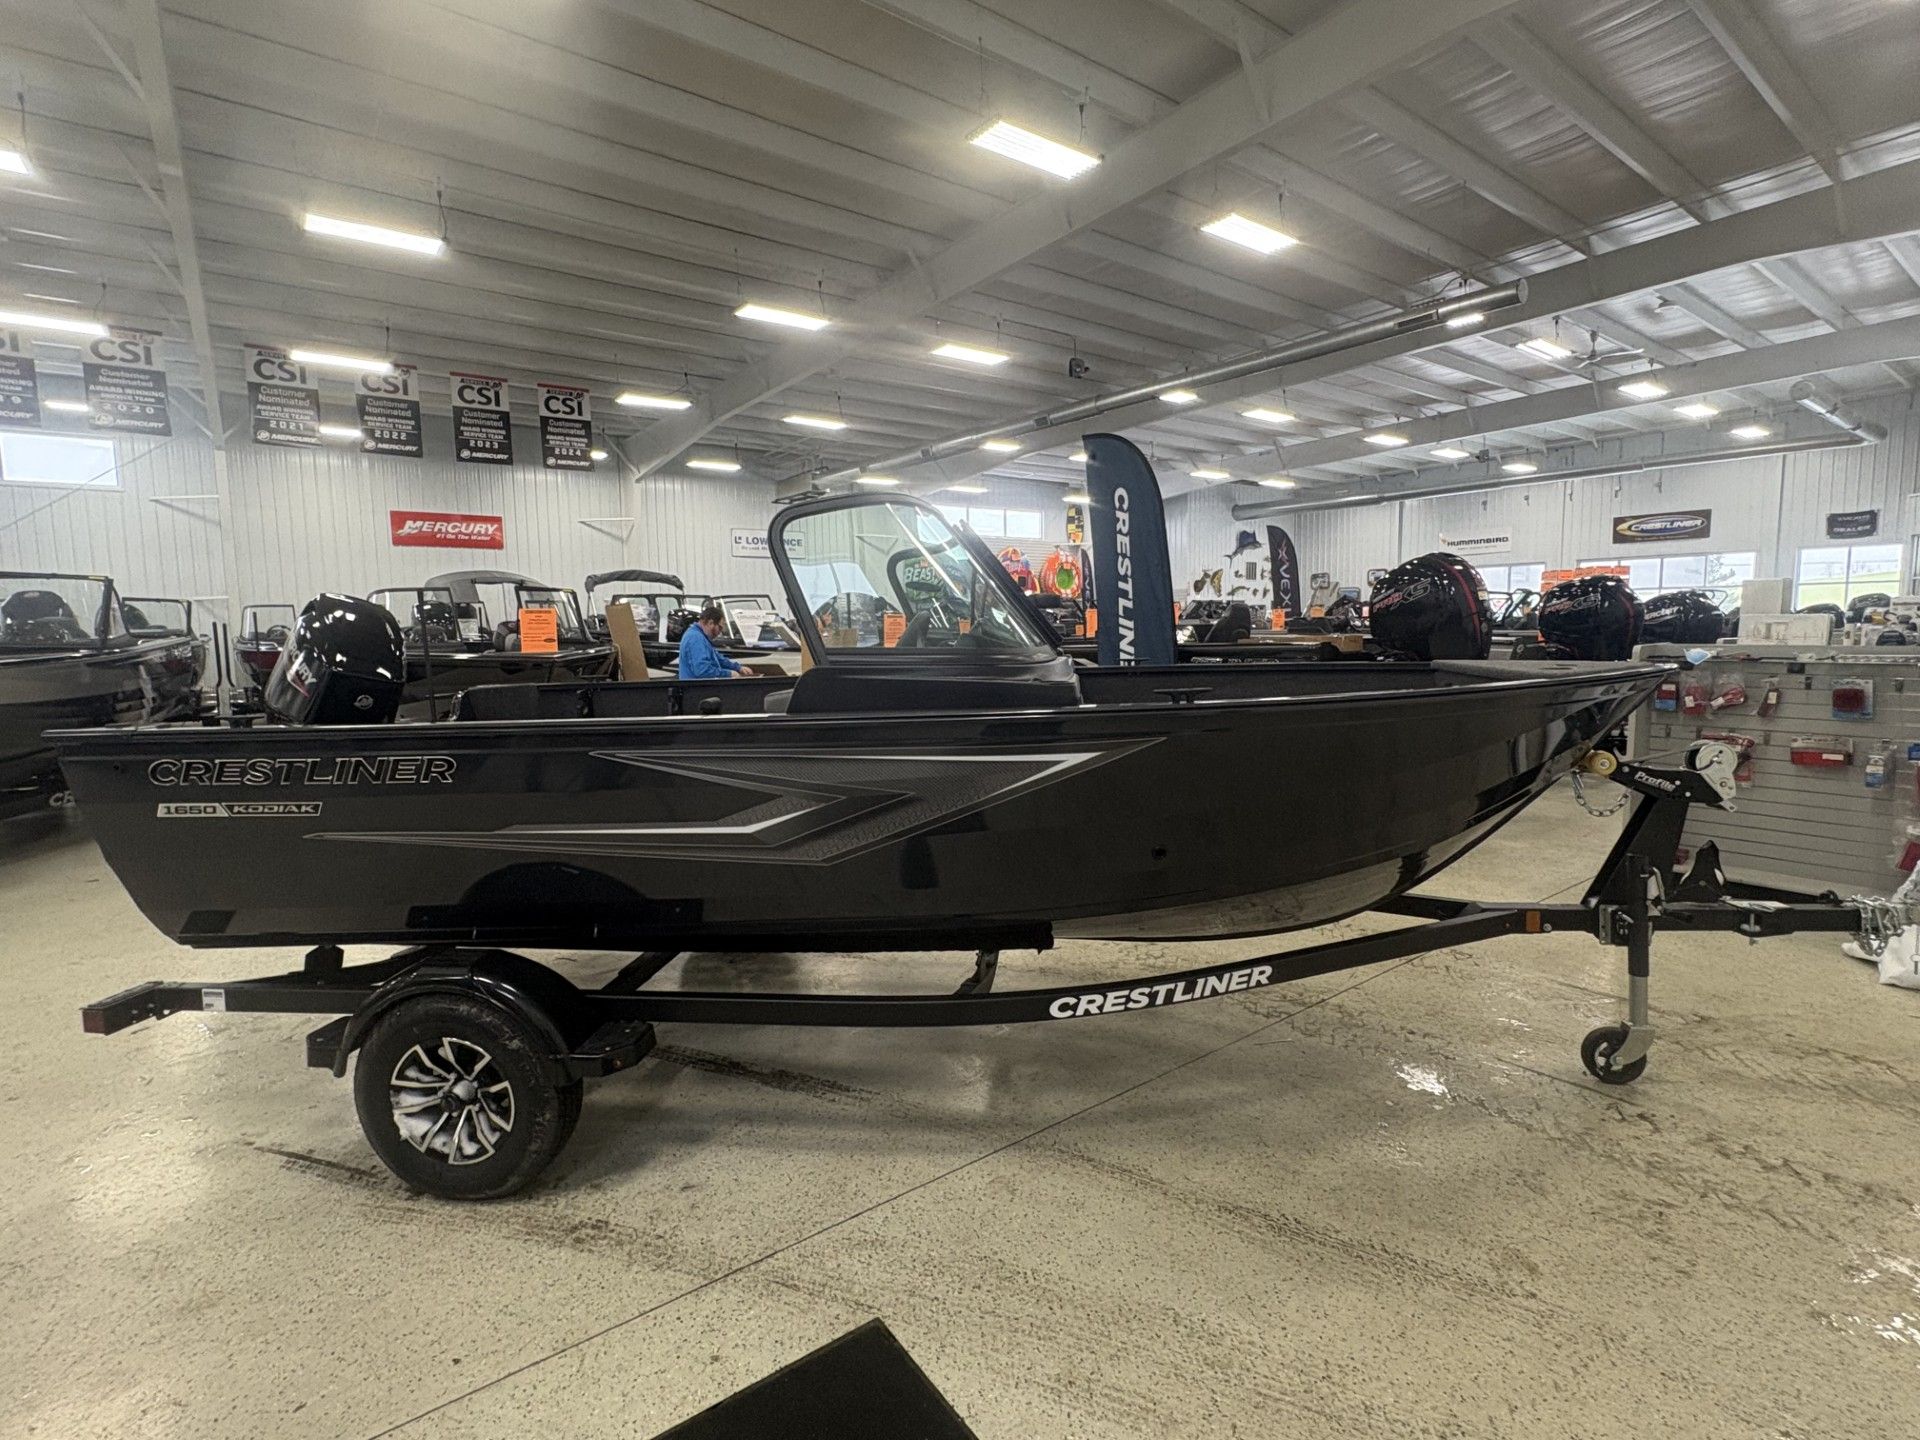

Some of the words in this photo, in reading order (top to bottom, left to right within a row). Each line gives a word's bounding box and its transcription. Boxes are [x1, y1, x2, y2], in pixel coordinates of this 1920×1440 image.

[396, 519, 498, 536] MERCURY
[1631, 519, 1703, 531] CRESTLINER
[746, 536, 803, 547] LOWNCE
[1114, 487, 1136, 666] CRESTLIN
[148, 755, 457, 786] CRESTLINER
[1634, 771, 1676, 791] Profile
[163, 805, 218, 815] 1650
[233, 804, 316, 815] KODIAK
[1049, 965, 1273, 1019] CRESTLINER
